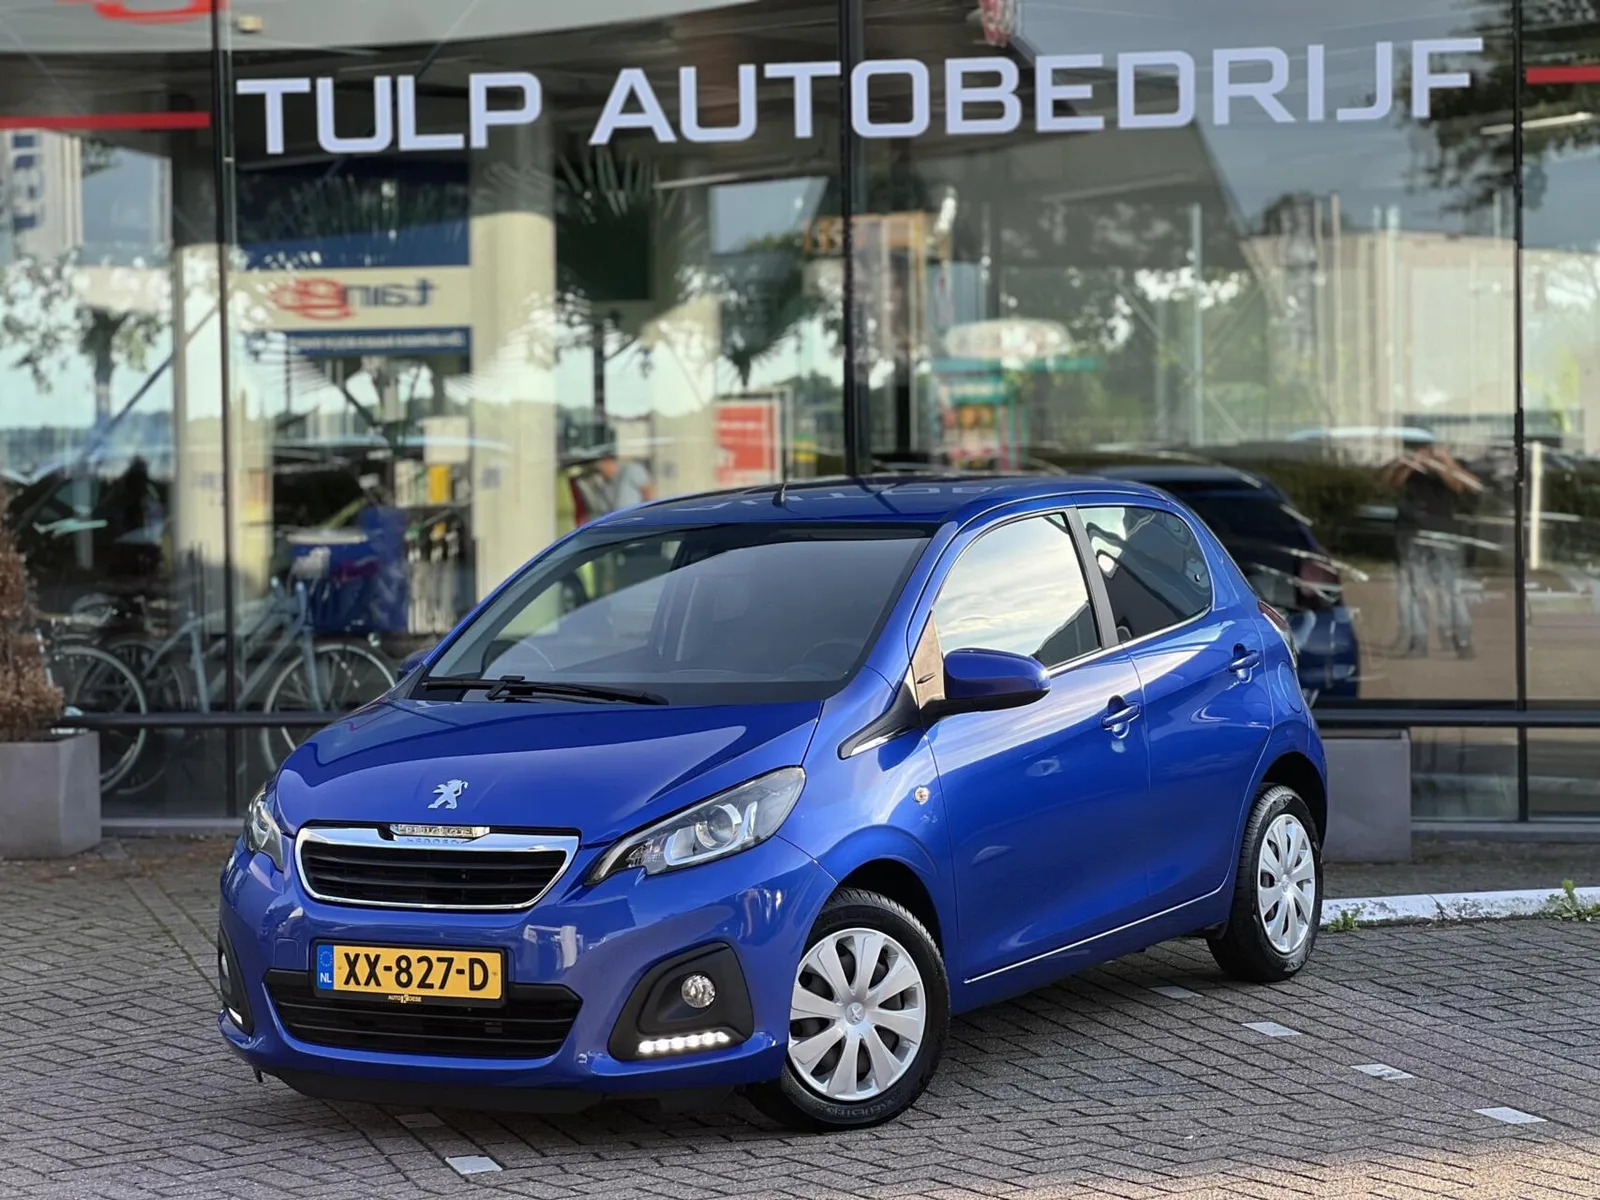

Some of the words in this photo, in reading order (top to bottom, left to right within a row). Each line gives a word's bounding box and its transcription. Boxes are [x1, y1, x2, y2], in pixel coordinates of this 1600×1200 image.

[236, 72, 542, 154] TULP
[589, 37, 1484, 145] AUTOBEDRIJF
[320, 972, 332, 983] NL
[343, 952, 489, 991] XX-827-D
